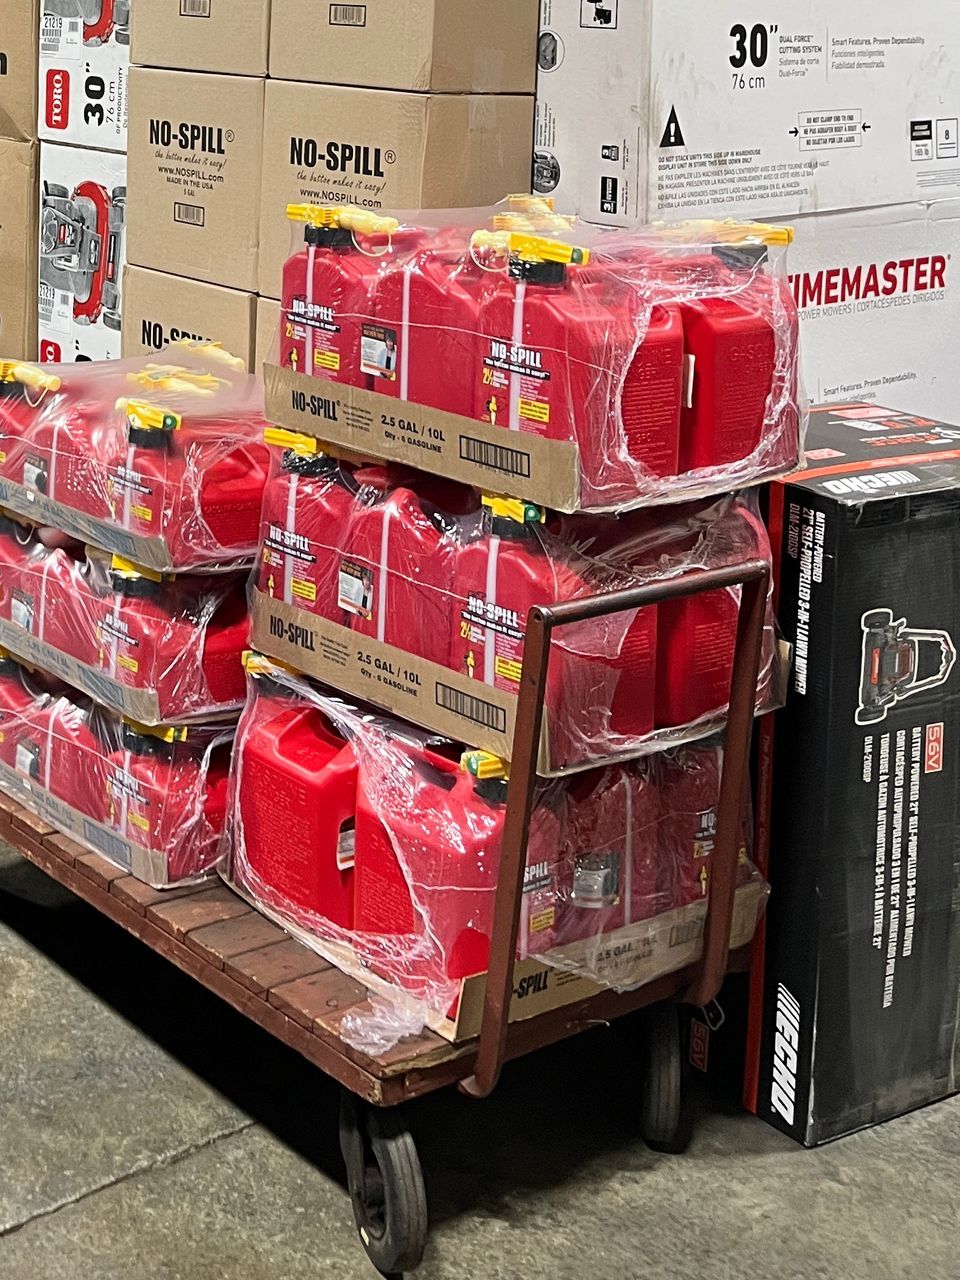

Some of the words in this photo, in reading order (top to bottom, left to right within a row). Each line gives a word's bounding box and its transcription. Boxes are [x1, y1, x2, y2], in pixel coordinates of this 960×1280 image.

[44, 17, 63, 29] 21219
[779, 45, 801, 55] CUTTING
[802, 45, 822, 55] SYSTEM
[732, 74, 745, 90] 76
[748, 76, 766, 89] cm
[52, 74, 62, 125] TORO
[116, 121, 121, 135] OF
[157, 166, 224, 183] www.NOSPILL.com
[167, 176, 182, 185] MADE
[183, 178, 188, 186] IN
[189, 179, 201, 188] THE
[202, 181, 214, 191] USA
[300, 187, 382, 209] www.NOSPILL.com
[292, 300, 334, 322] NO-SPILL
[822, 303, 852, 318] MOWERS
[912, 291, 945, 306] DIRIGIDOS
[491, 341, 542, 369] NO-SPILL
[381, 414, 396, 427] 2.5
[398, 418, 419, 434] GAL
[427, 427, 445, 442] 10L
[269, 525, 310, 551] NO-SPILL
[787, 503, 800, 559] DLM-2100SP
[797, 524, 813, 599] SELF-PROPELLED
[812, 511, 826, 583] BATTERY-POWERED
[468, 595, 519, 628] NO-SPILL
[795, 599, 809, 628] 3-IN-1
[795, 628, 808, 657] LAWN
[357, 650, 371, 664] 2.5
[374, 656, 395, 675] GAL
[403, 668, 421, 686] 10L
[794, 657, 807, 695] MOWER
[911, 727, 921, 762] BATTERY
[862, 736, 873, 783] DLM-2100SP
[910, 763, 920, 801] POWERED
[907, 816, 918, 878] SELF-PROPELLED
[906, 878, 917, 902] 3-IN-1
[905, 903, 916, 927] LAWN
[902, 927, 915, 957] MOWER
[770, 982, 801, 1125] ECHO
